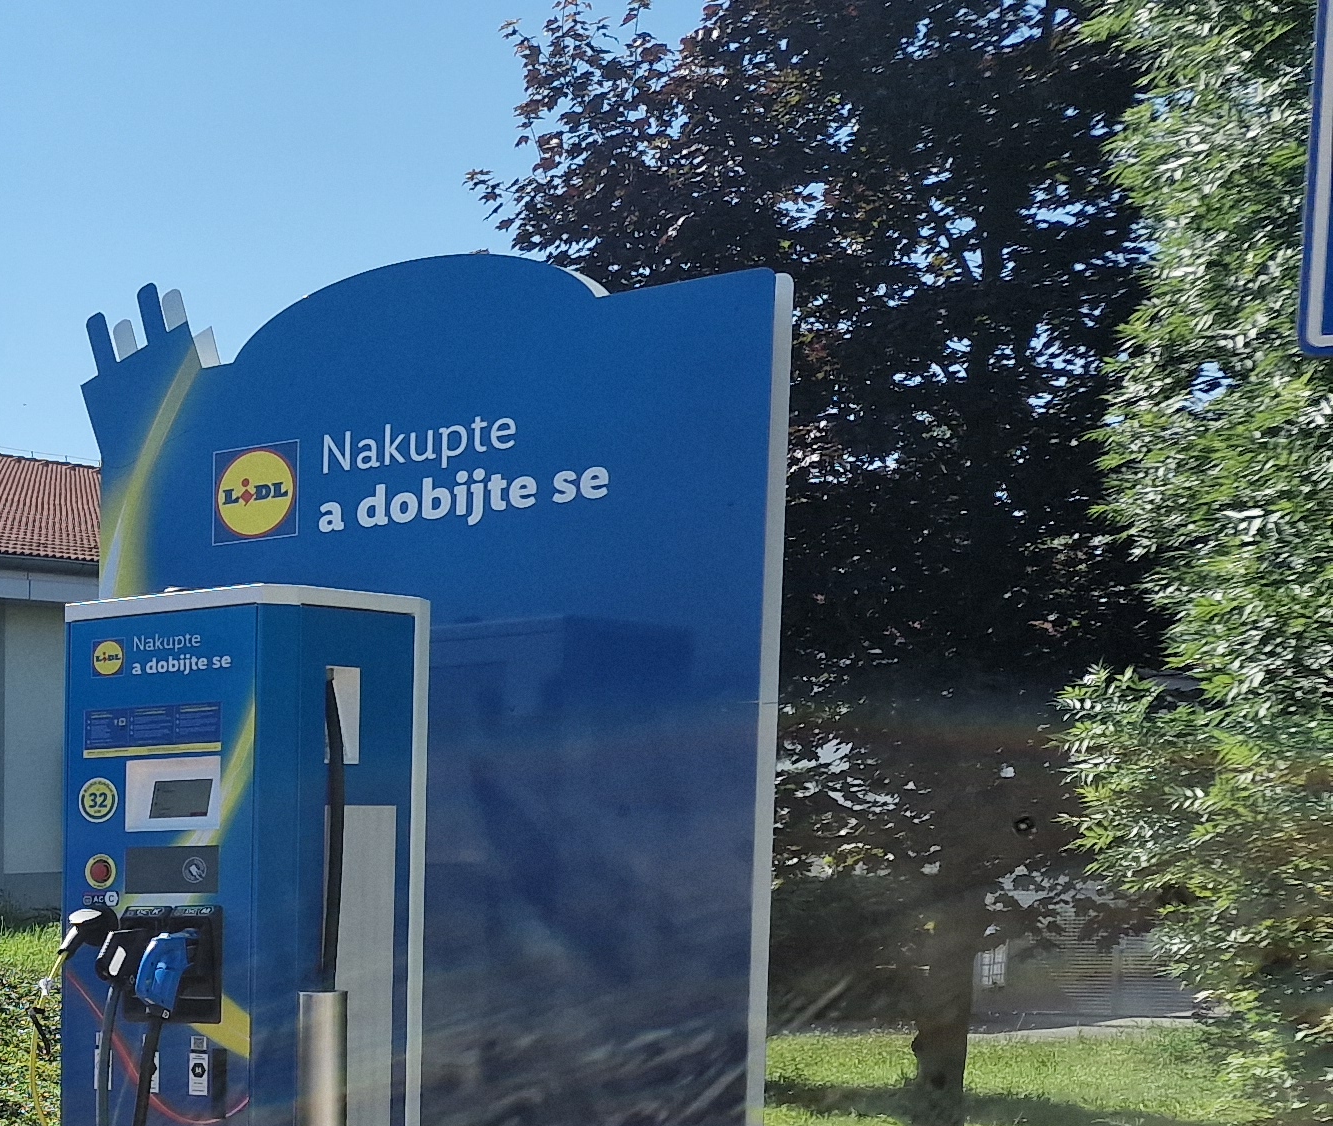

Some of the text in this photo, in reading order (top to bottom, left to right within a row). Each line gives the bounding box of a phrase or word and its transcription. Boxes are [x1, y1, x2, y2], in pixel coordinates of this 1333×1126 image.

[322, 415, 517, 475] Nakupte
[222, 478, 289, 507] LIDL
[318, 465, 611, 533] a dobijte se
[133, 633, 201, 652] Nakupte
[95, 651, 122, 663] LIDL
[131, 654, 232, 675] a dobijte se
[88, 791, 108, 808] 32
